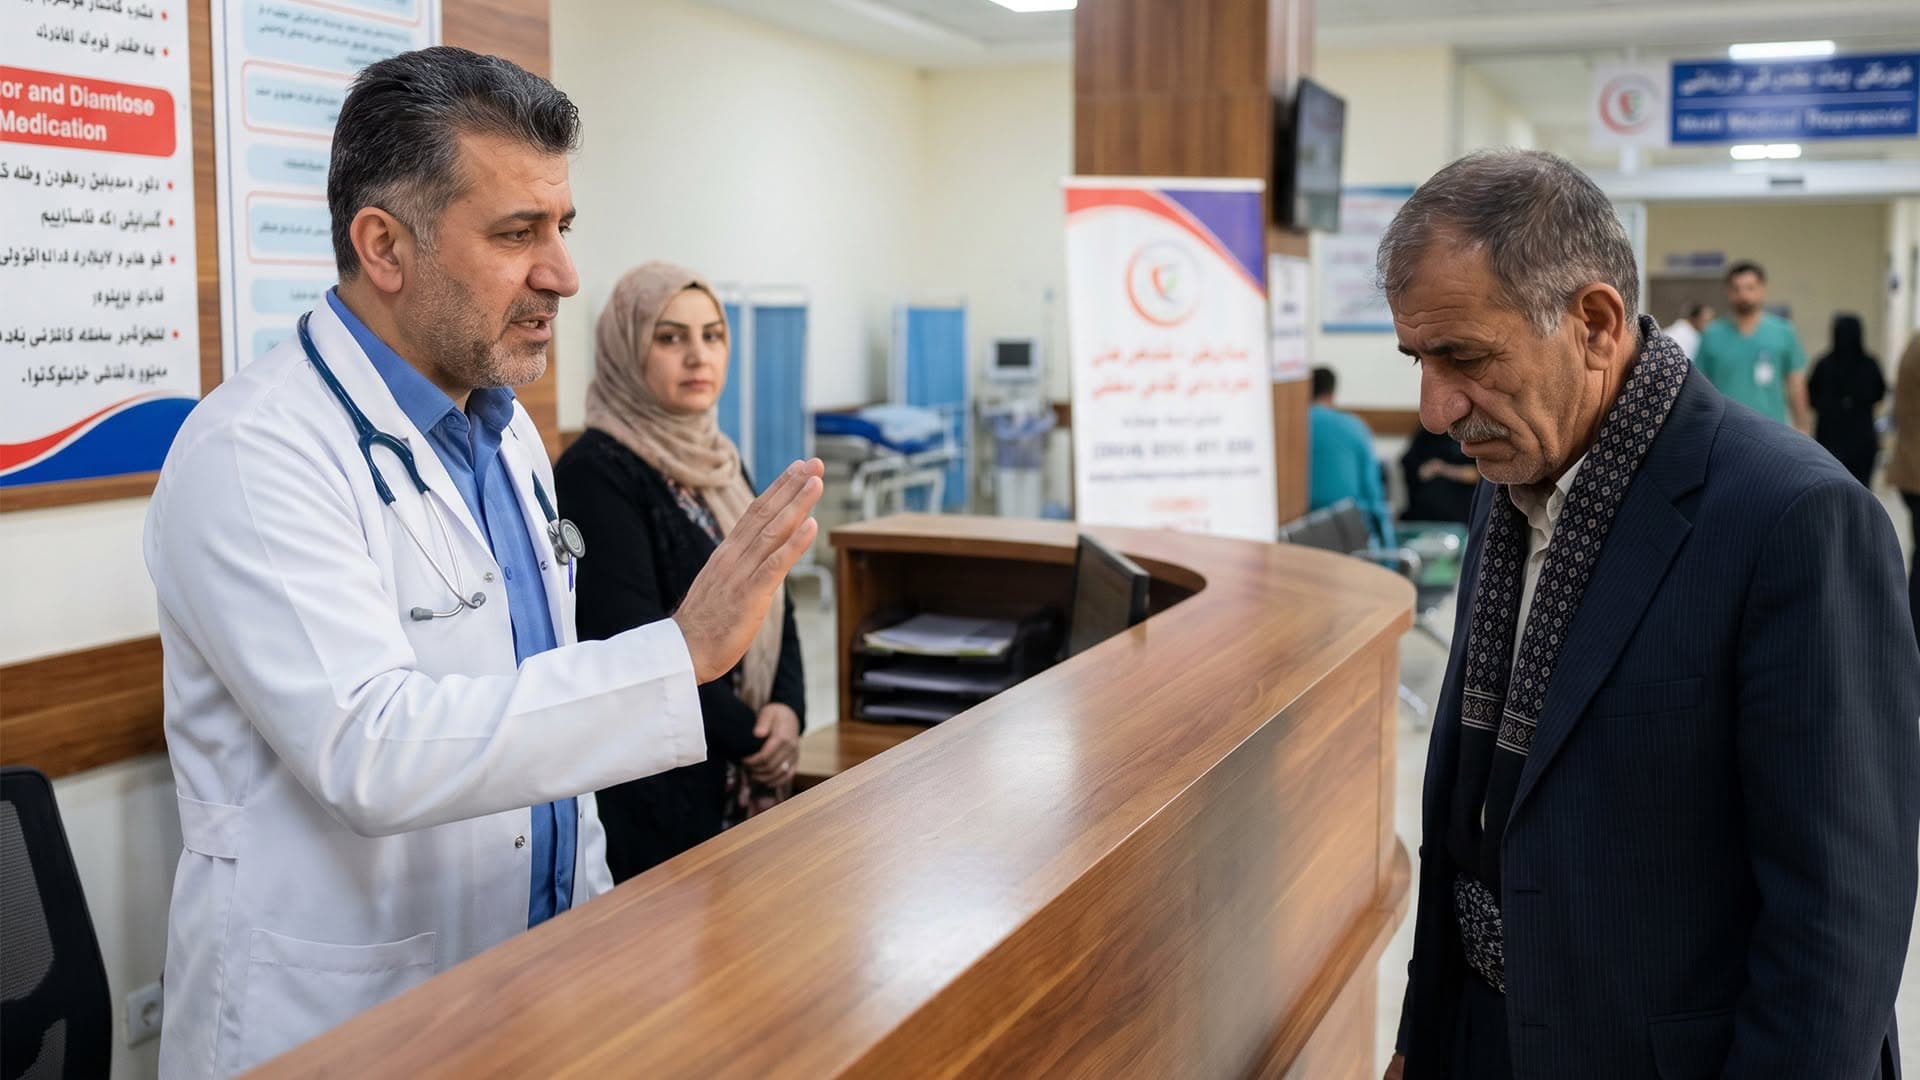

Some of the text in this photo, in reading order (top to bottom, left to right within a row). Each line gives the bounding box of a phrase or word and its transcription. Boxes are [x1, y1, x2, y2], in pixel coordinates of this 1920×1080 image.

[28, 83, 65, 105] and
[69, 85, 155, 117] Diamtose
[0, 109, 108, 142] Medication
